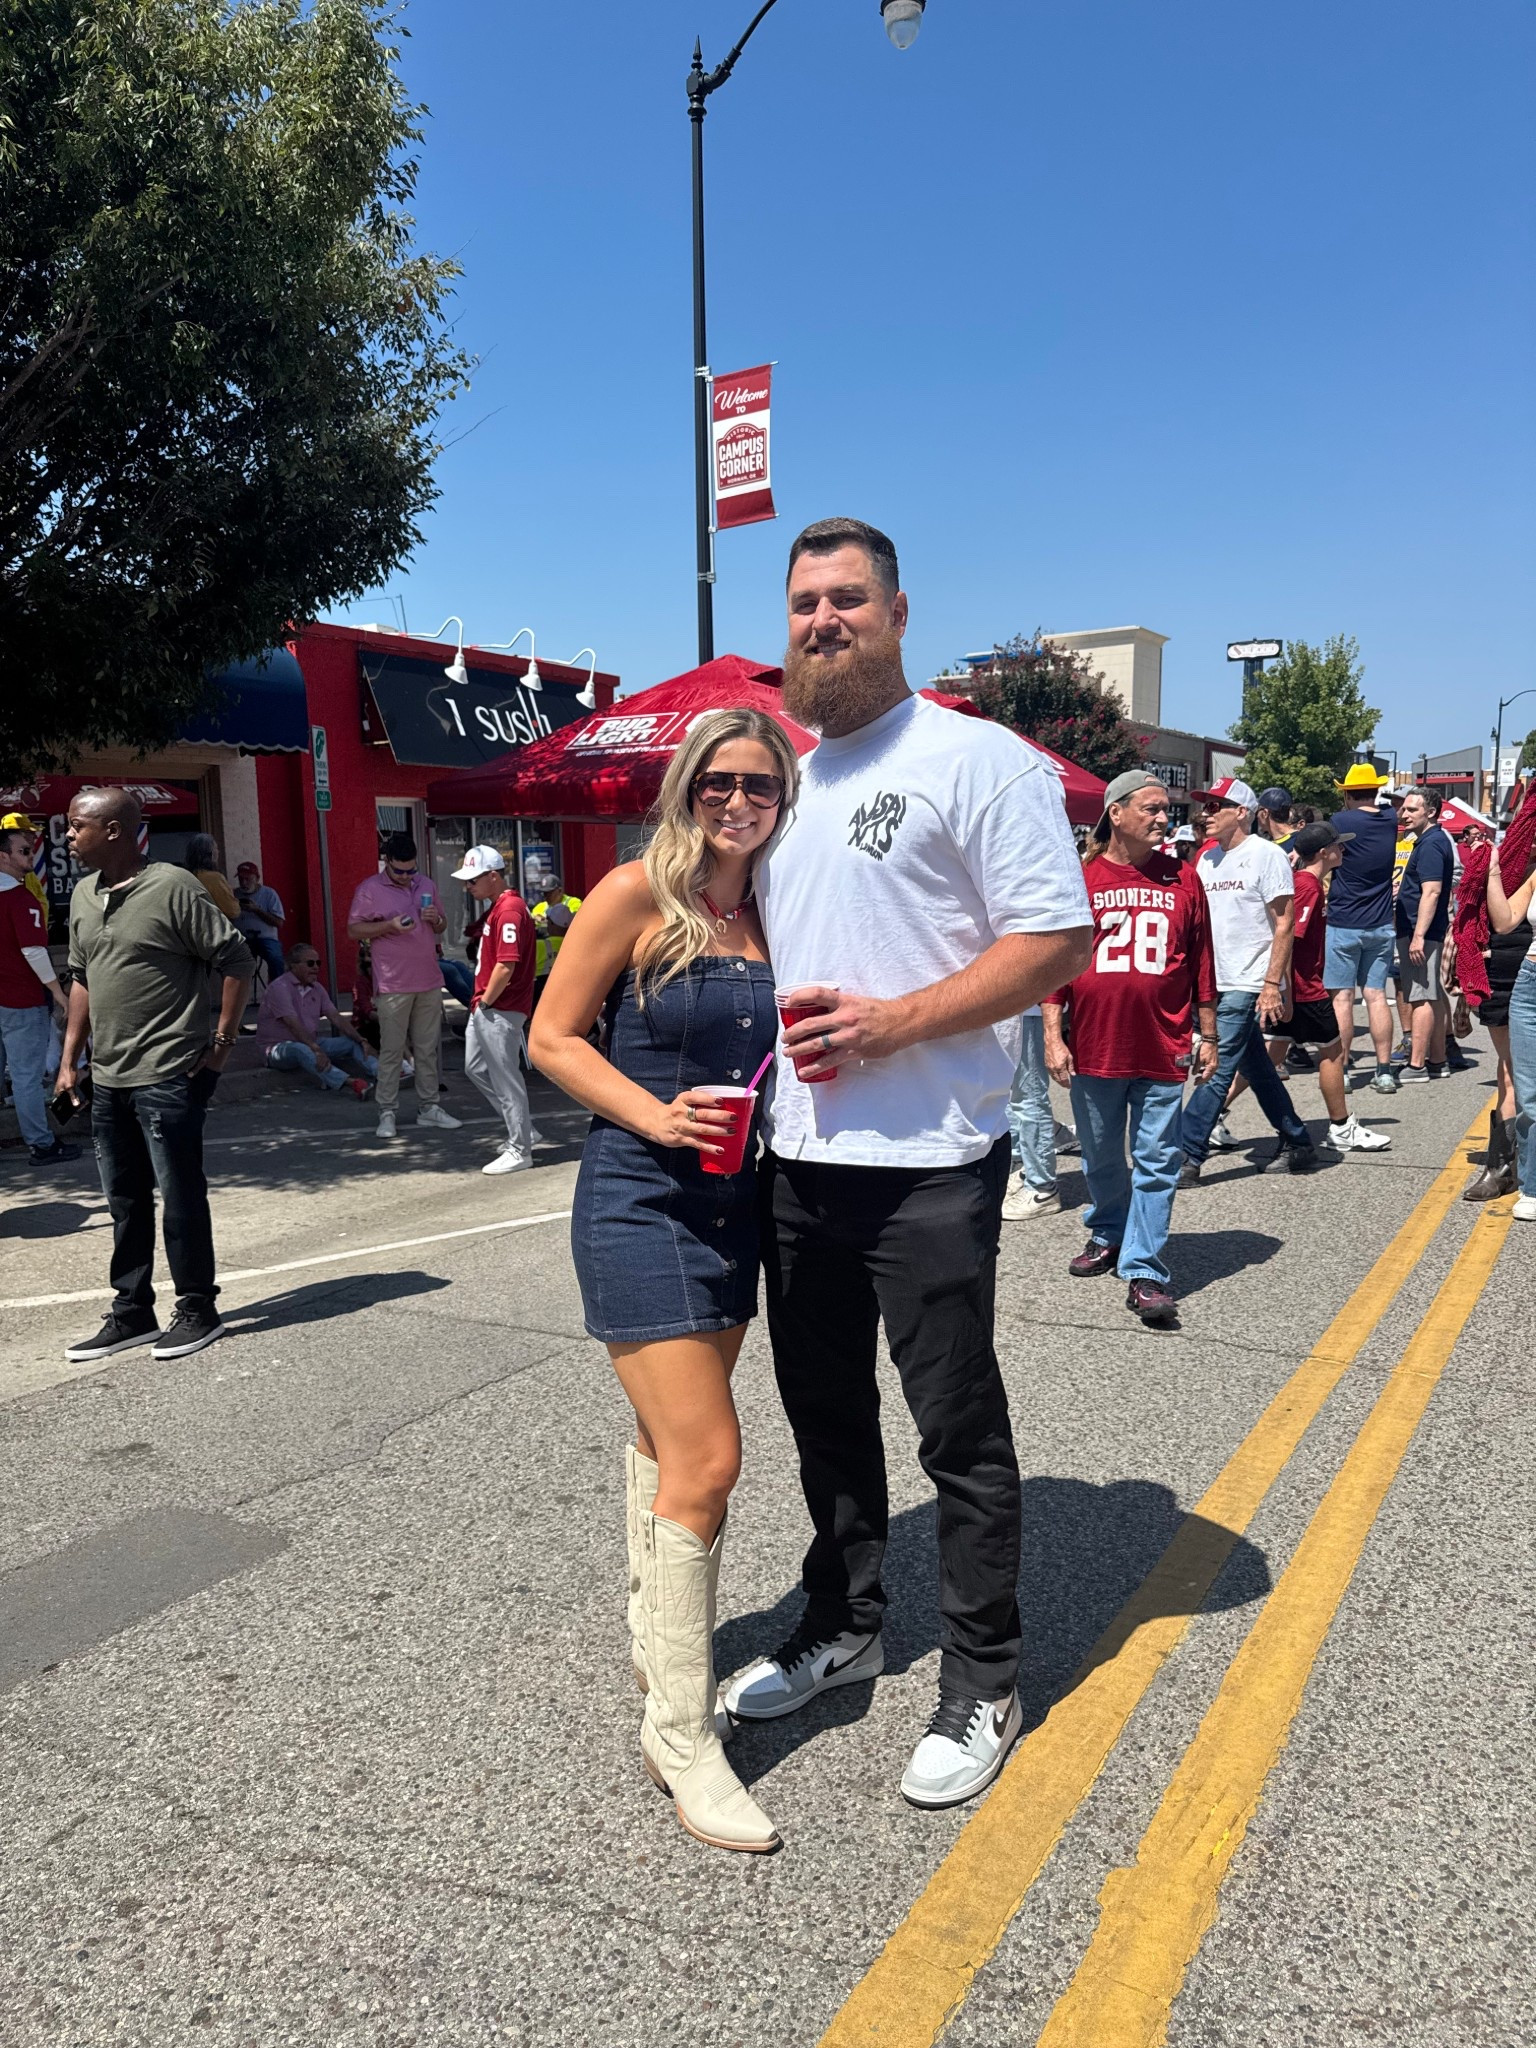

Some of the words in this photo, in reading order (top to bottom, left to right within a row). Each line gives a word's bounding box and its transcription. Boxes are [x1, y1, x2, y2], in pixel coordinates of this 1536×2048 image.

[714, 387, 768, 410] Welcome
[735, 405, 746, 414] TO
[726, 427, 756, 442] HISTORIC
[719, 435, 764, 462] CAMPUS
[719, 453, 764, 479] CORNER
[596, 717, 658, 734] BUD
[572, 728, 659, 747] LIGHT
[1093, 888, 1175, 911] SOONERS
[29, 908, 42, 928] 7
[1298, 906, 1310, 923] 1
[502, 923, 517, 944] 6
[1096, 910, 1169, 975] 28
